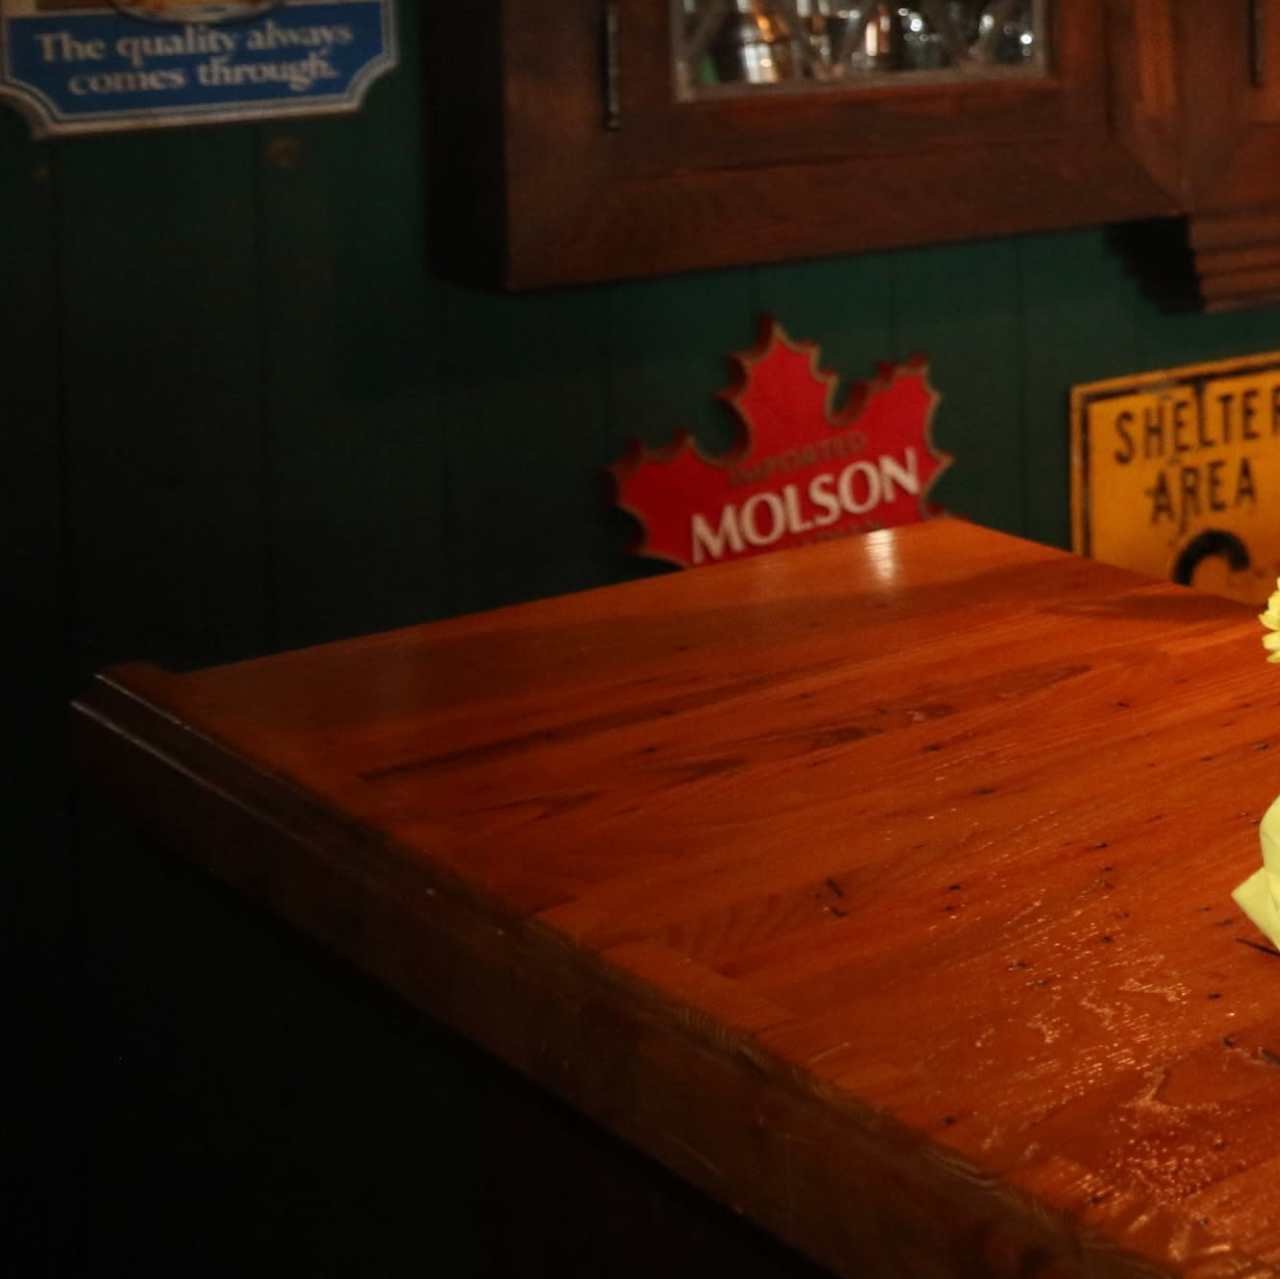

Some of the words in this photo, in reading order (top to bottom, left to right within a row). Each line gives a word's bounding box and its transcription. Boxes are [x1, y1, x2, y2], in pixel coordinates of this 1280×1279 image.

[37, 30, 105, 65] The
[116, 22, 240, 68] quality
[245, 19, 354, 52] always
[66, 64, 186, 97] comes
[691, 446, 920, 565] MOLSON
[1150, 457, 1257, 524] AREA
